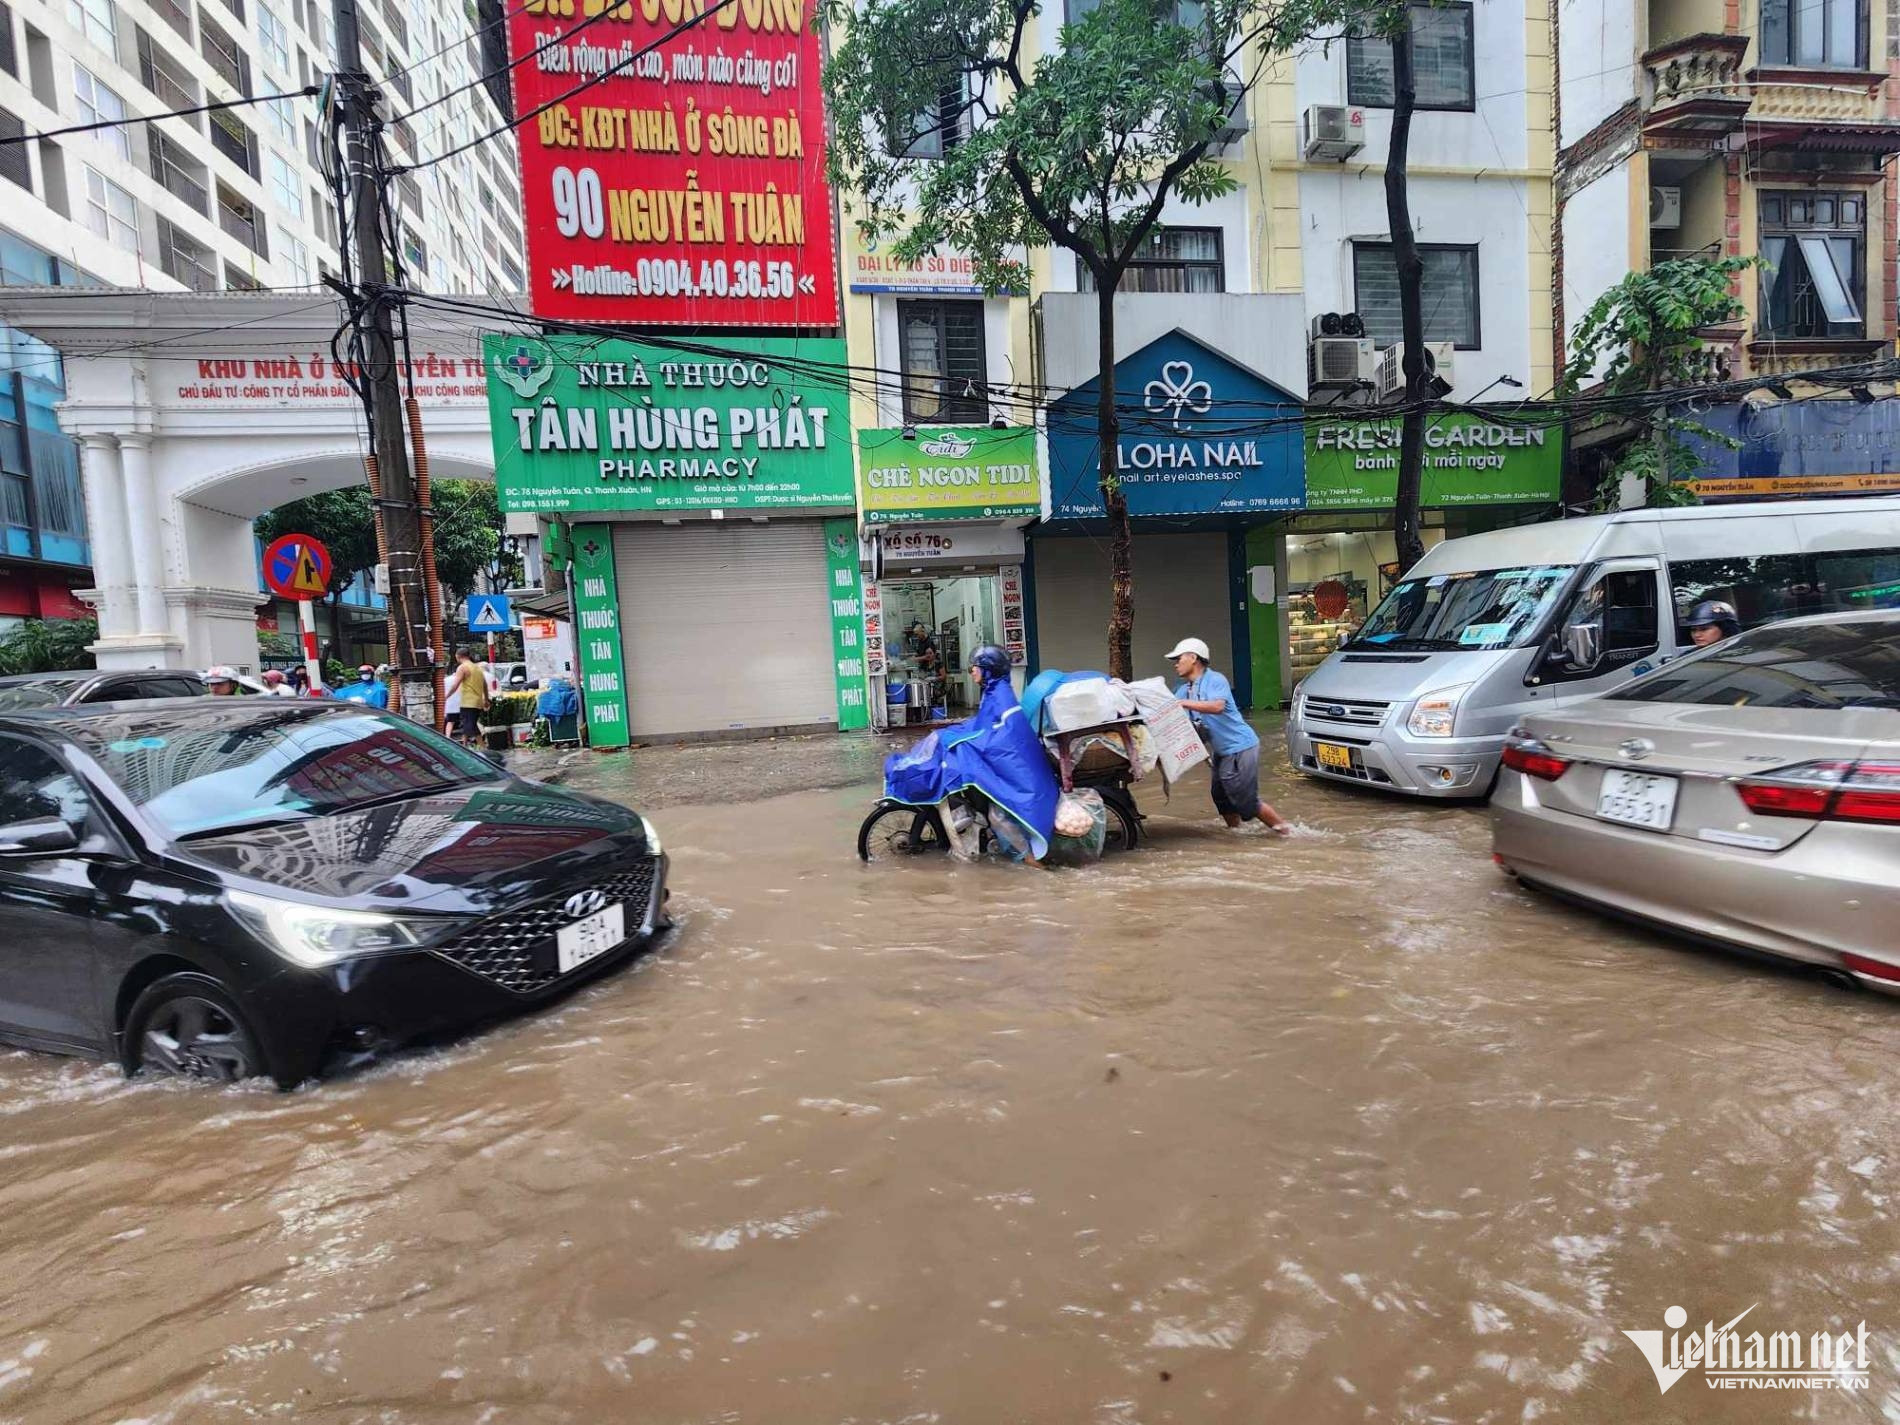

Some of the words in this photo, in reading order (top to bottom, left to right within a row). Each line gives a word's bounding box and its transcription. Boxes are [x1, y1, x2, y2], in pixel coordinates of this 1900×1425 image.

[673, 44, 704, 82] món
[708, 47, 734, 83] nào
[736, 50, 771, 94] cũng
[539, 103, 578, 146] ĐC:
[581, 107, 626, 149] KĐT
[630, 101, 680, 152] NHÀ
[686, 96, 701, 153] Ở
[707, 105, 768, 157] SÔNG
[773, 108, 804, 157] ĐÀ
[552, 166, 604, 239] 90
[608, 168, 725, 244] NGUYỄN
[731, 181, 805, 246] TUÂN
[858, 255, 880, 275] ĐẠI
[928, 252, 945, 272] SỐ
[198, 359, 246, 379] KHU
[254, 355, 303, 379] NHÀ
[309, 352, 324, 379] Ở
[578, 354, 651, 387] NHÀ
[660, 357, 769, 387] THUỐC
[179, 382, 198, 398] CHỦ
[202, 383, 221, 398] ĐẦU
[273, 386, 284, 397] TY
[415, 385, 433, 396] KHU
[435, 383, 460, 396] CÔNG
[511, 396, 598, 450] TÂN
[608, 396, 719, 450] HÙNG
[729, 395, 828, 448] PHÁT
[1424, 425, 1544, 448] GARDEN
[1097, 442, 1197, 469] LOHA
[1203, 441, 1264, 467] NAIL
[1355, 452, 1395, 469] bánh
[1435, 449, 1462, 467] mỗi
[1467, 451, 1505, 470] ngày
[600, 457, 759, 479] PHARMACY
[868, 463, 912, 488] CHÈ
[918, 465, 981, 487] NGON
[986, 464, 1032, 484] TIDI
[594, 486, 617, 494] Thanh
[905, 531, 922, 549] SỐ
[925, 535, 940, 548] 76
[584, 574, 606, 597] NHÀ
[835, 566, 853, 587] NHÀ
[580, 603, 615, 629] THUỐC
[832, 596, 860, 617] THUỐC
[840, 625, 857, 646] TÂN
[590, 638, 612, 660] TÂN
[838, 656, 862, 677] HÙNG
[589, 669, 618, 692] HÙNG
[841, 686, 863, 706] PHÁT
[593, 702, 620, 723] PHÁT
